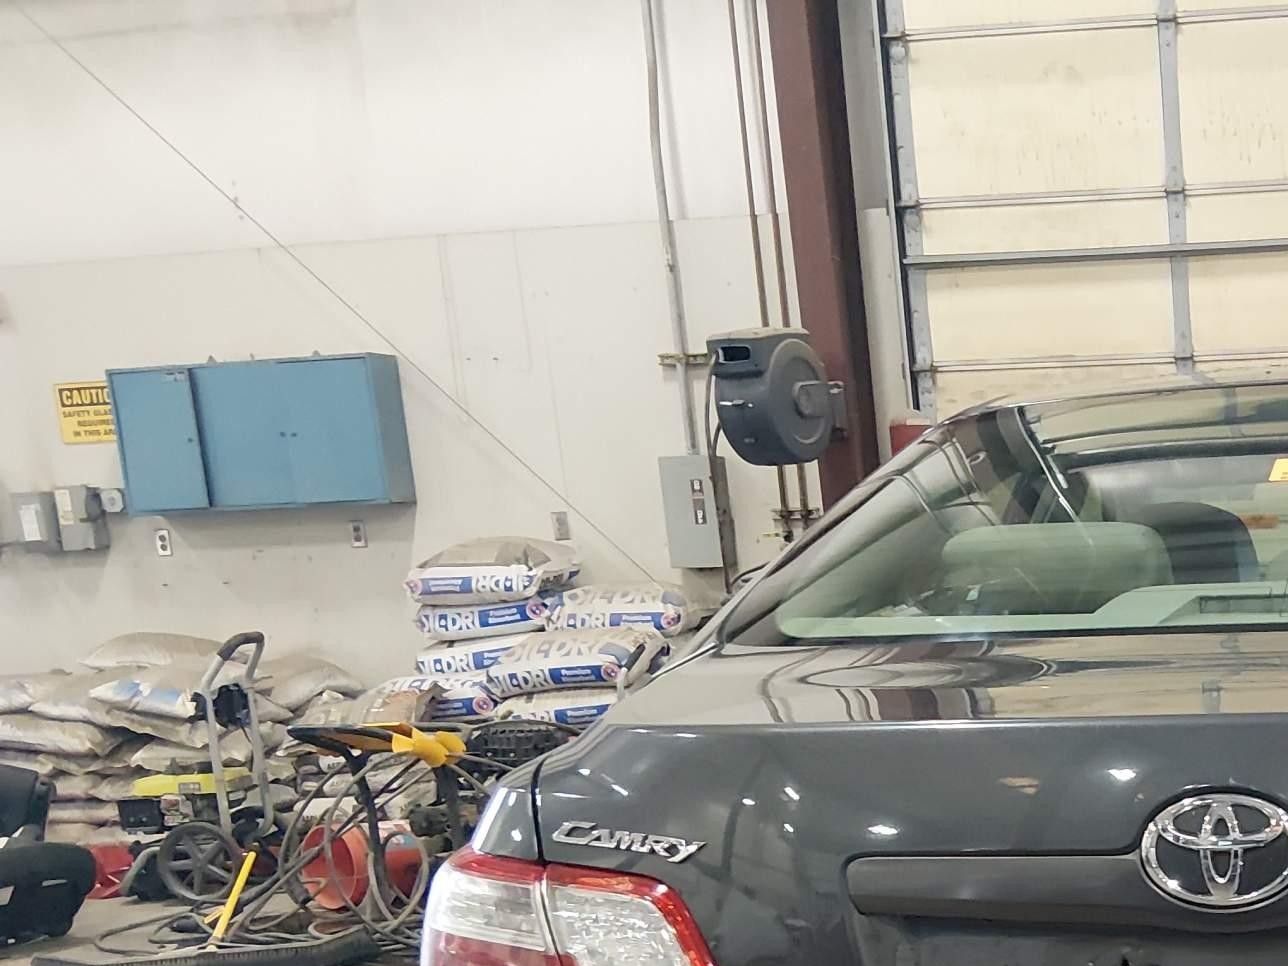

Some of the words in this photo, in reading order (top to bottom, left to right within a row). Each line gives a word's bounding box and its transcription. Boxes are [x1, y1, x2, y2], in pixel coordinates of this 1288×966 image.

[61, 389, 111, 405] CAUTIO
[62, 409, 90, 418] SAFETY
[552, 820, 707, 863] CAMRY
